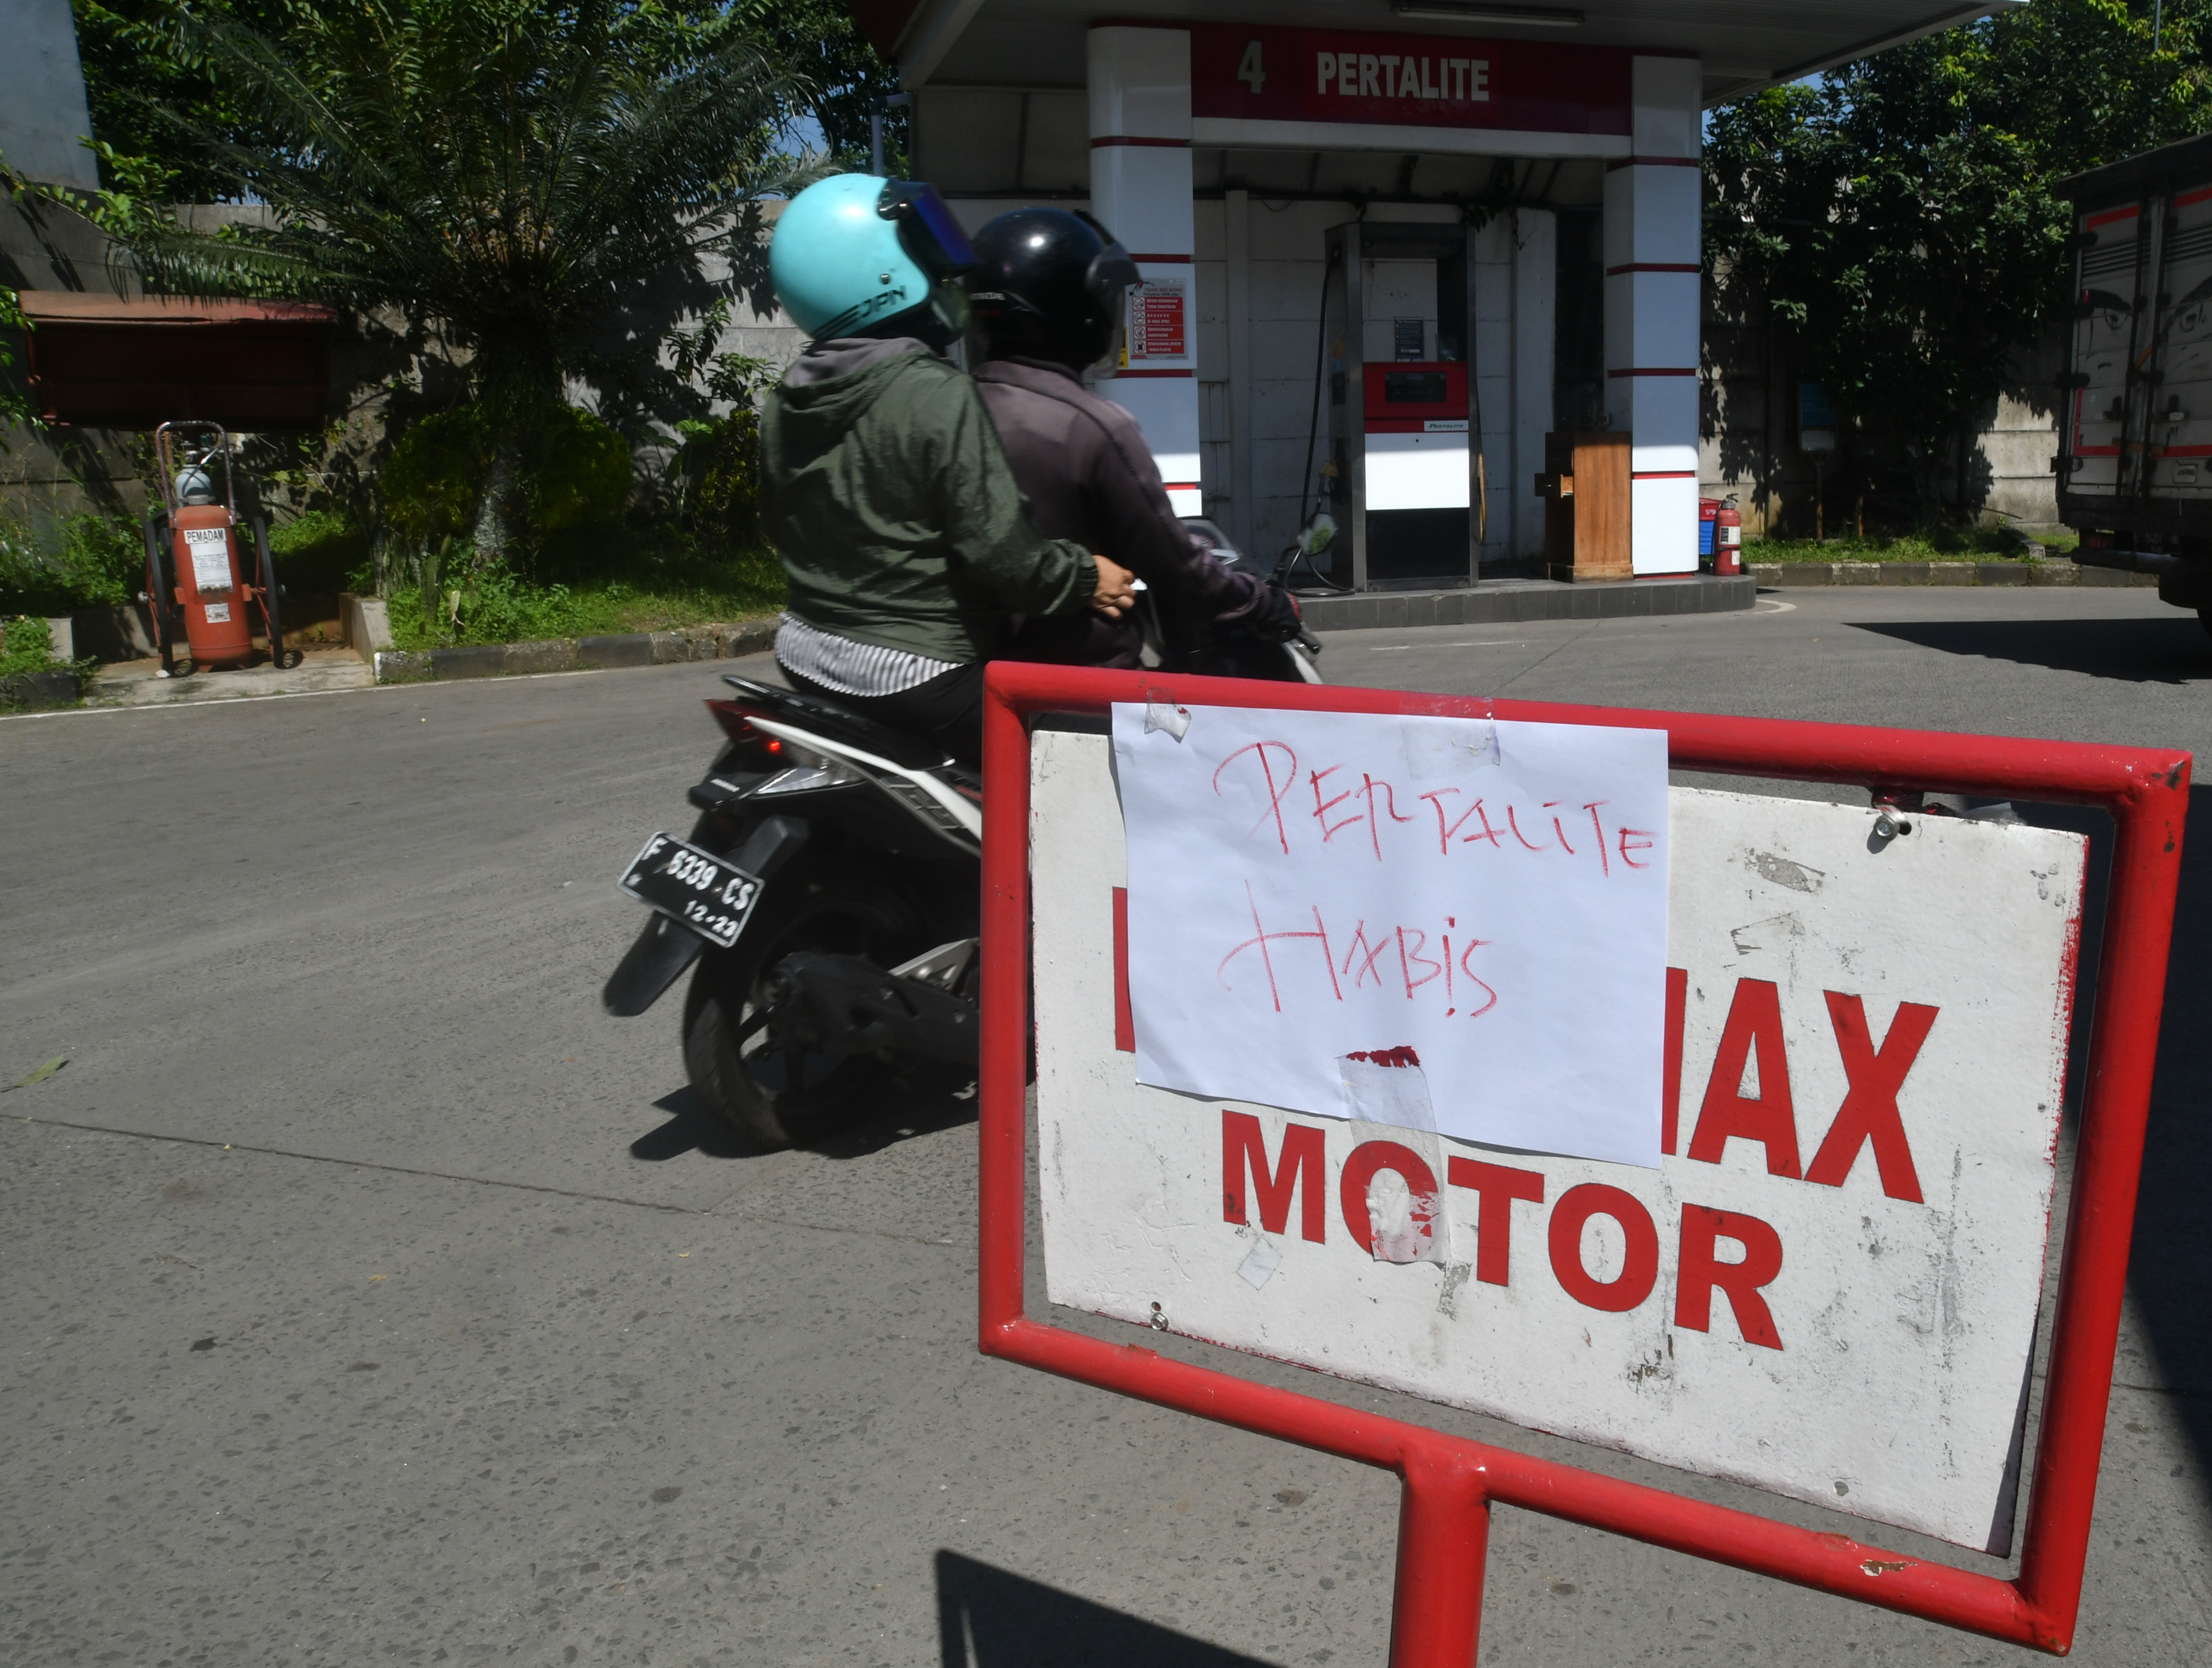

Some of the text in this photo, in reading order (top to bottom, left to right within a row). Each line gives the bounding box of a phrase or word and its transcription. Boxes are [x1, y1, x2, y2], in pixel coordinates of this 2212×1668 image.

[1237, 39, 1489, 101] 4 PERTALITE
[187, 530, 224, 542] PEMADAM
[641, 838, 669, 860] F
[721, 877, 755, 911] CS
[1222, 1109, 1783, 1351] MOTOR
